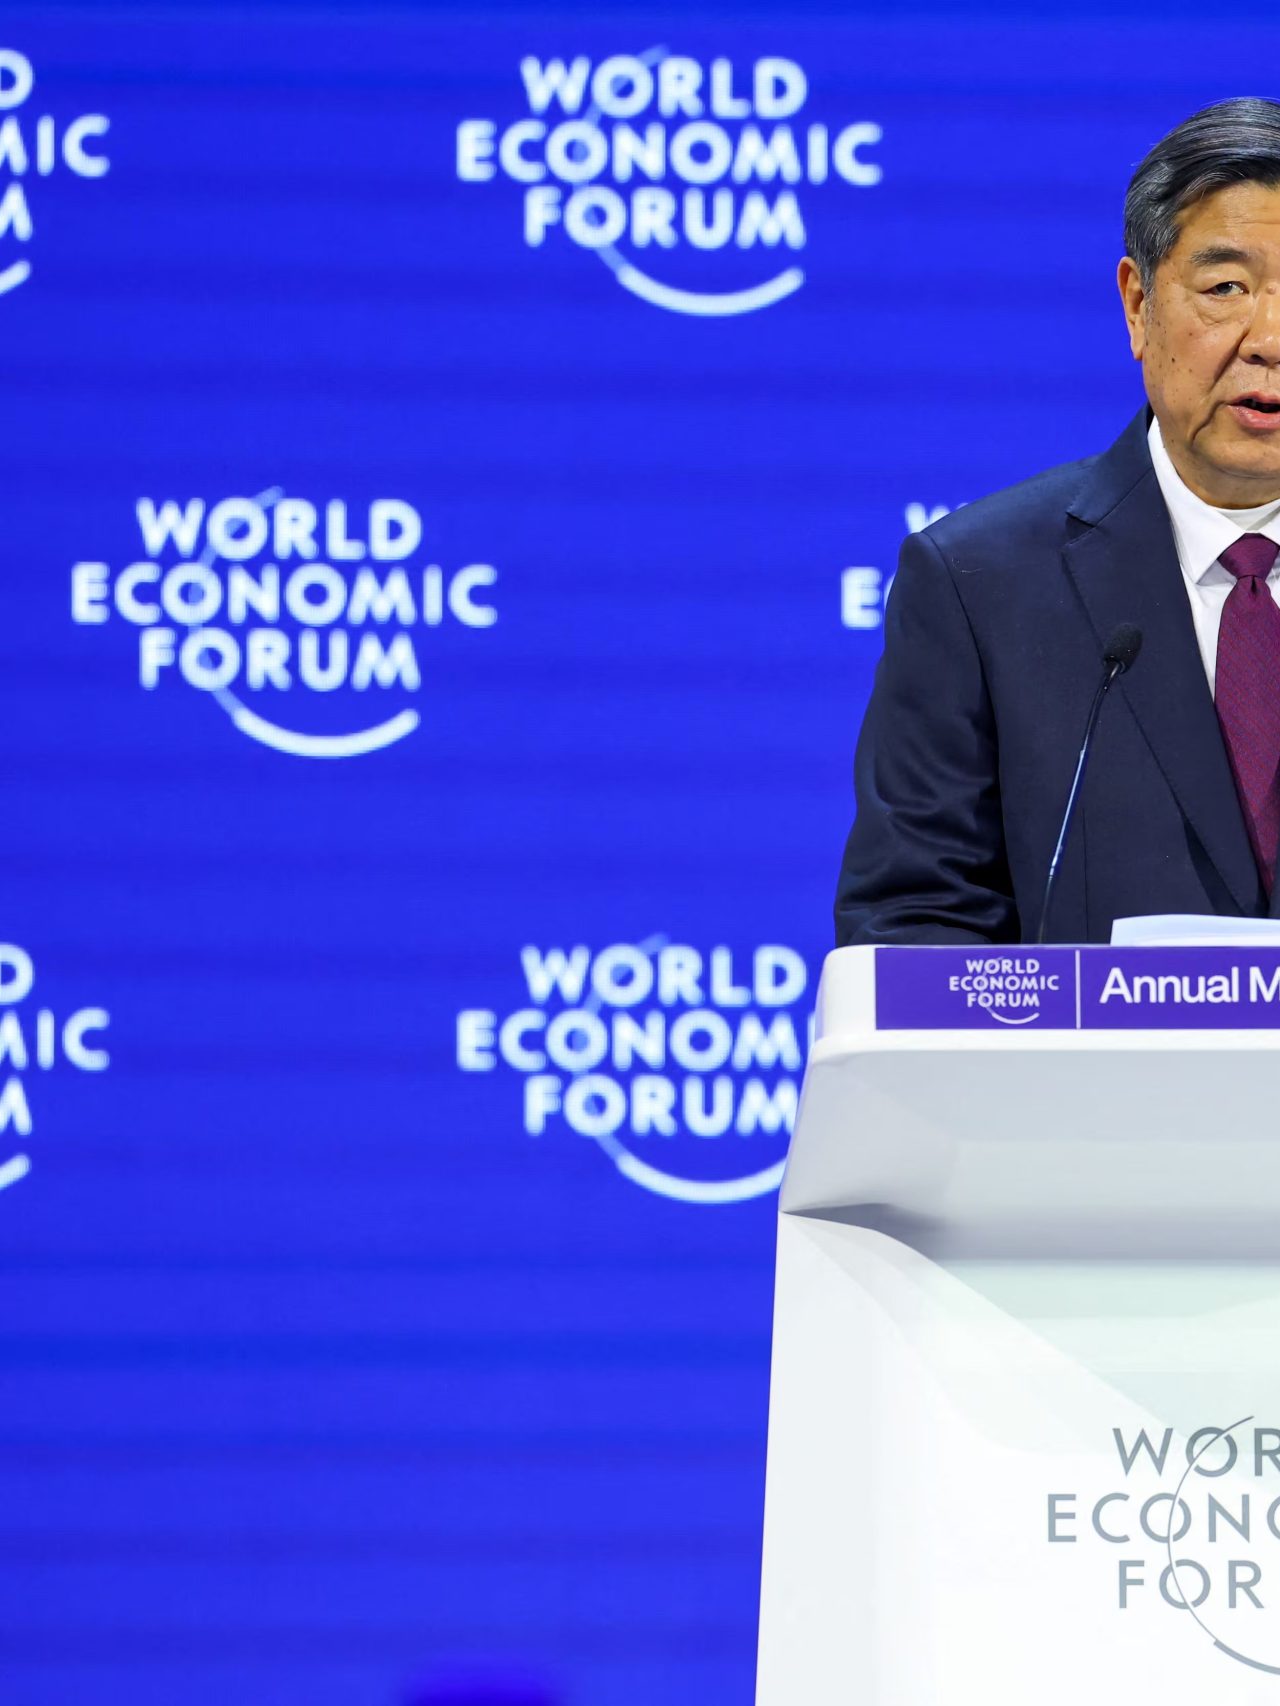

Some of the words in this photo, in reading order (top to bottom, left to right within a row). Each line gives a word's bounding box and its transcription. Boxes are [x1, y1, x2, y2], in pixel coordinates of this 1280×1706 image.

[521, 56, 807, 118] WORLD
[456, 120, 880, 186] ECONOMIC
[525, 186, 804, 249] FORUM
[136, 497, 421, 560] WORLD
[71, 562, 495, 626] ECONOMIC
[140, 627, 419, 692] FORUM
[522, 945, 807, 1007] WORLD
[950, 976, 1058, 991] ECONOMIC
[967, 959, 1039, 974] WORLD
[1100, 967, 1239, 1003] Annual
[968, 993, 1039, 1007] FORUM
[456, 1009, 812, 1072] ECONOM
[525, 1074, 798, 1139] FORUM
